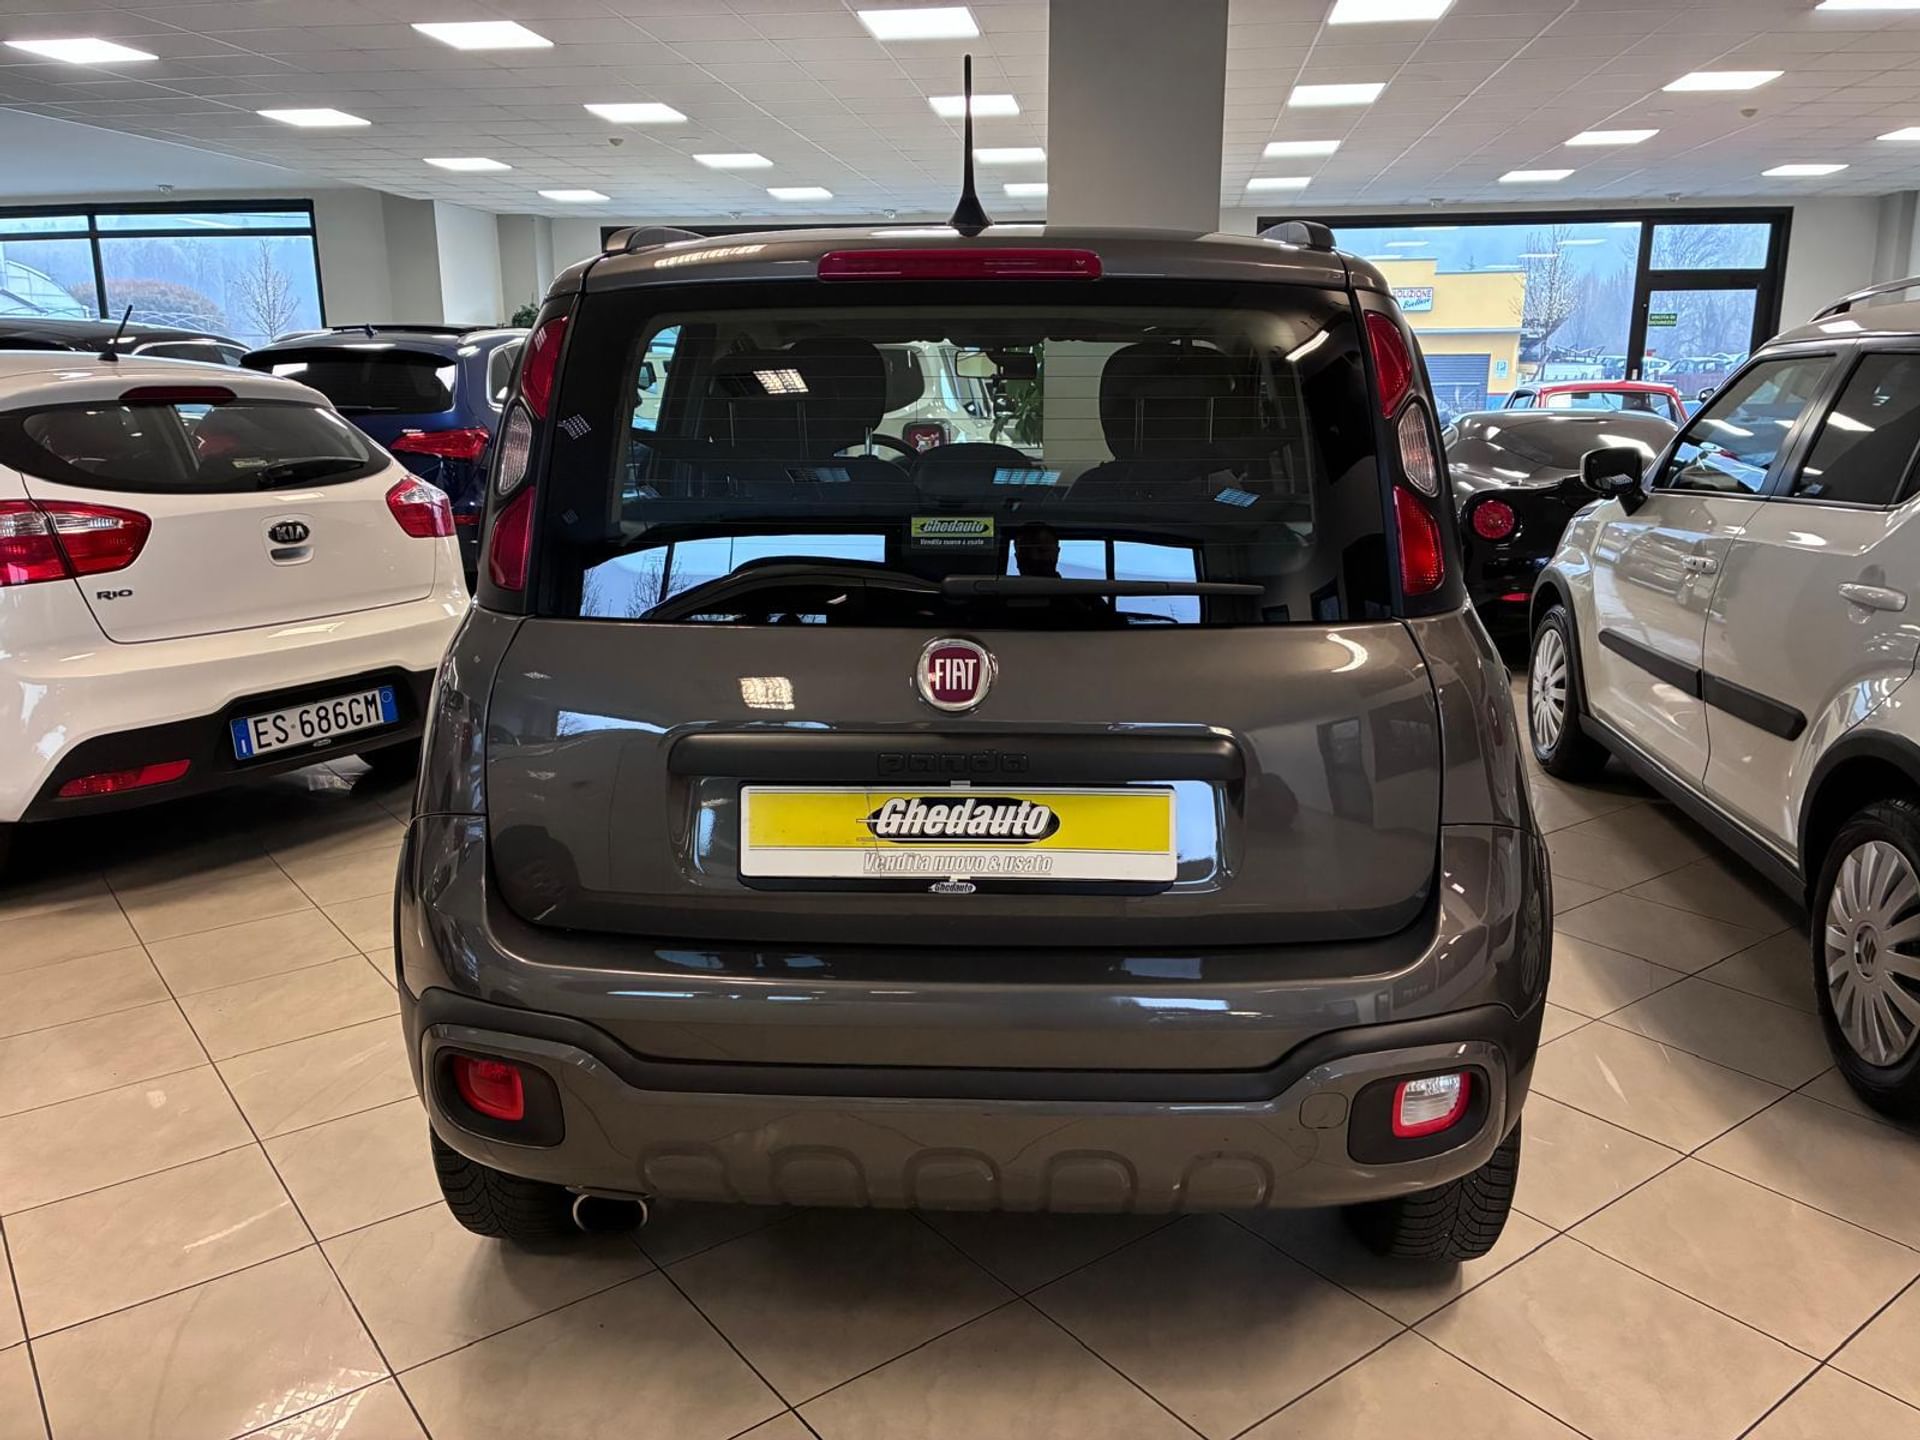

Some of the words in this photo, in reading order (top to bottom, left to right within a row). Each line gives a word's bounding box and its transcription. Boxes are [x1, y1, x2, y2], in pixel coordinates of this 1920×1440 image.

[275, 525, 306, 541] KIA
[935, 658, 977, 691] FIAT
[253, 714, 290, 750] ES
[298, 692, 381, 738] 686GM
[875, 797, 1052, 837] Ghedauto
[863, 852, 932, 873] Vendita
[932, 854, 986, 873] nuovo
[986, 855, 1001, 873] &
[1002, 853, 1054, 873] usato
[933, 881, 974, 894] Ghedauto
